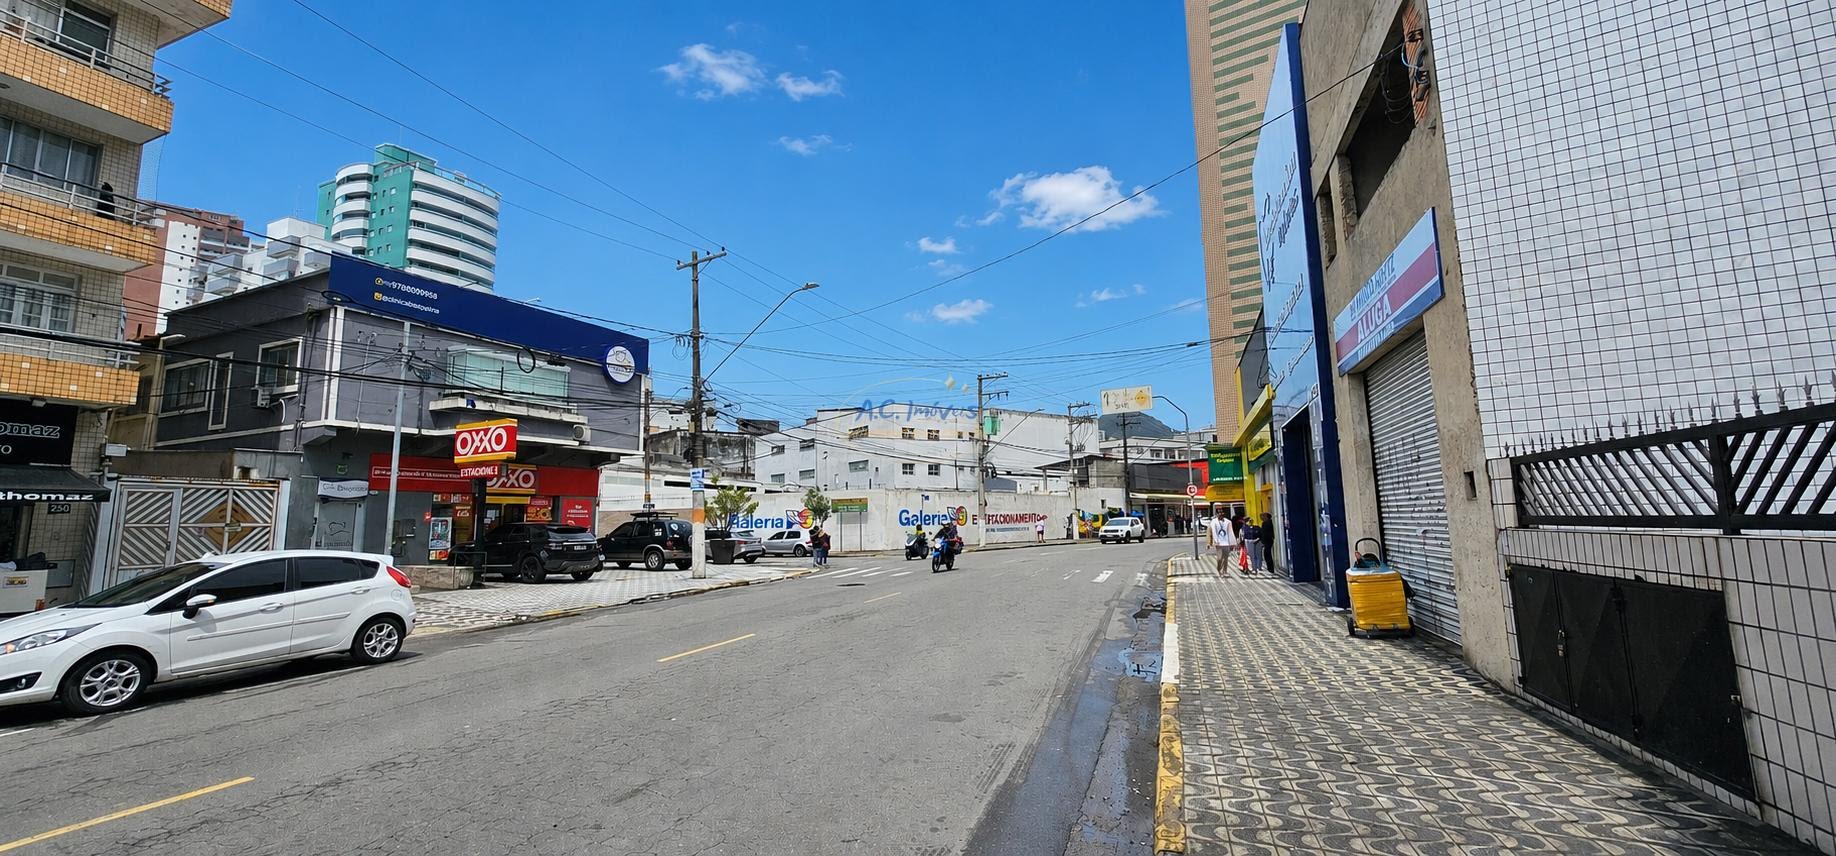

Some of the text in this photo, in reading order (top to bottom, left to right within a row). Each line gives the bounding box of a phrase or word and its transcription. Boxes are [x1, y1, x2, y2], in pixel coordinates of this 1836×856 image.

[1357, 293, 1392, 344] ALUGA
[456, 426, 507, 456] OXXO
[898, 509, 947, 527] Galeria
